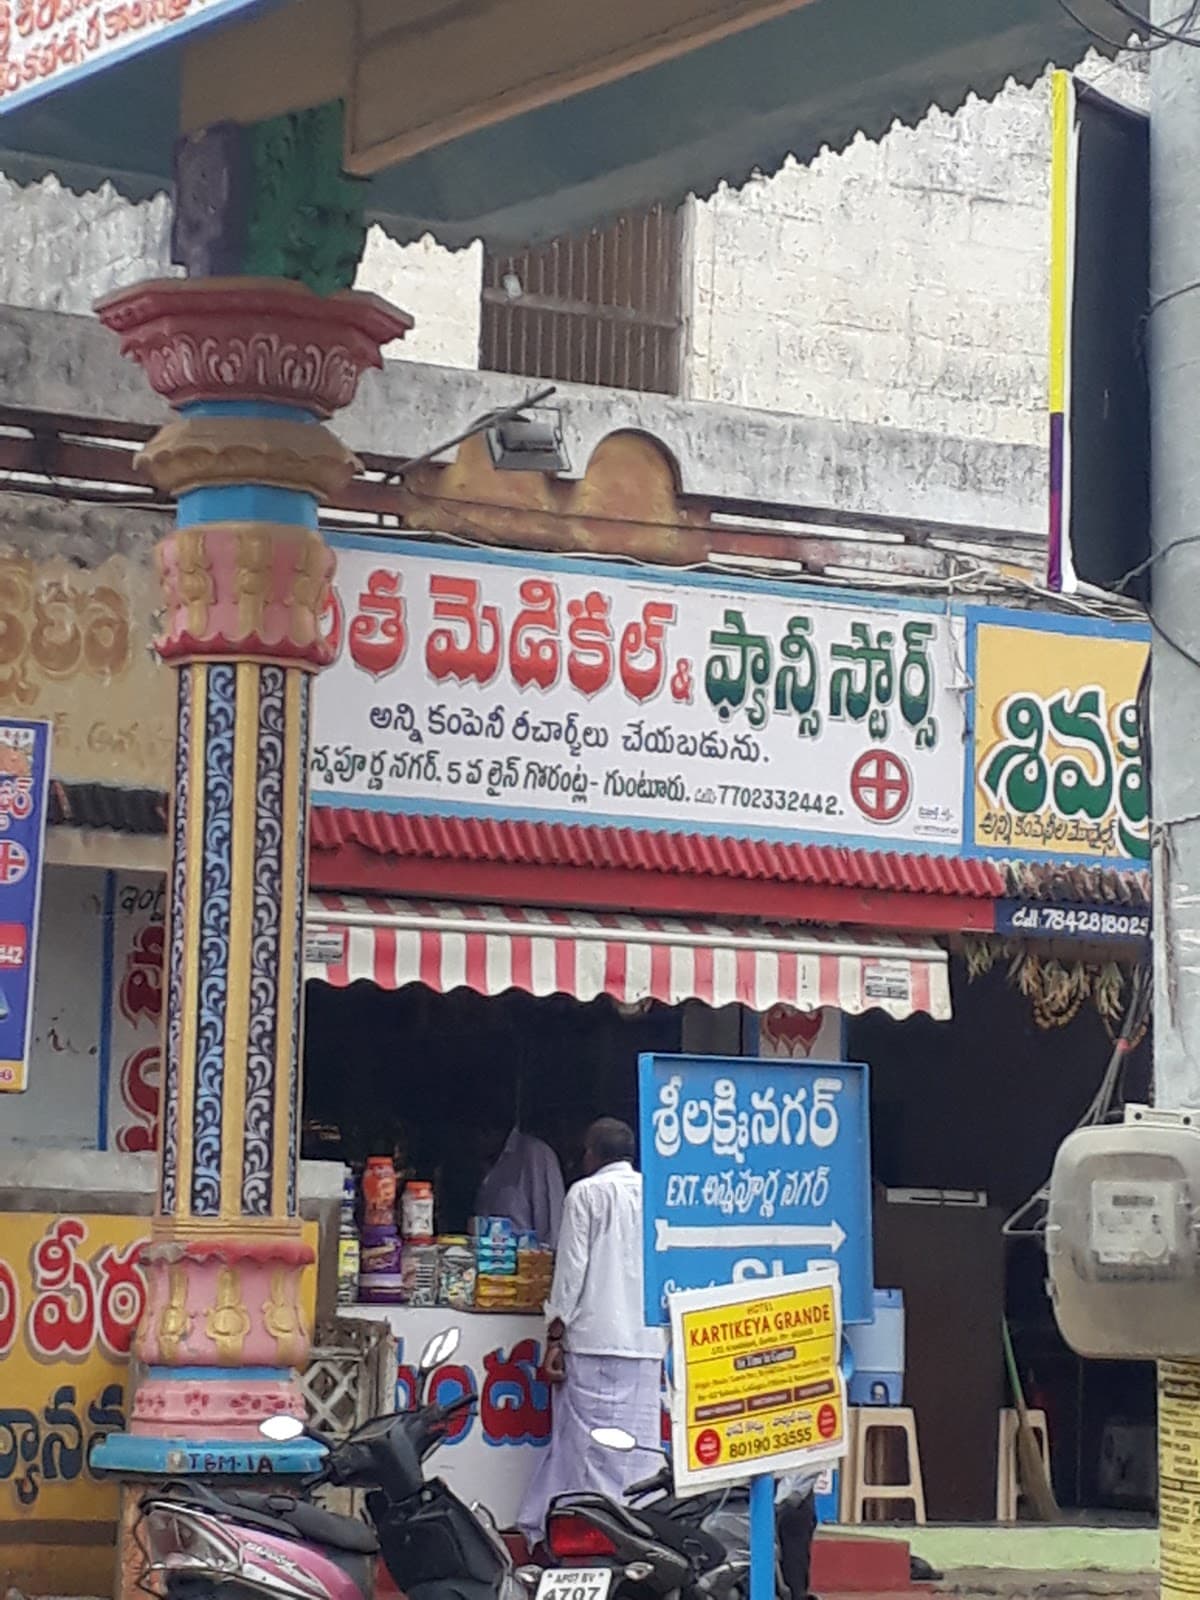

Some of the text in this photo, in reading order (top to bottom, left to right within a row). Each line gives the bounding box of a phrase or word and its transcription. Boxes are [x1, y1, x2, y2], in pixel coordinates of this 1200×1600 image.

[320, 569, 408, 679] తి
[424, 573, 675, 701] మెడికల్
[671, 657, 692, 701] &
[369, 702, 424, 744] అన్ని
[427, 703, 505, 740] కంపెనీ
[310, 744, 387, 791] న్నపూర్ణ
[447, 761, 462, 785] 5
[689, 1314, 771, 1347] KARTIKEYA
[773, 1303, 832, 1333] GRANDE
